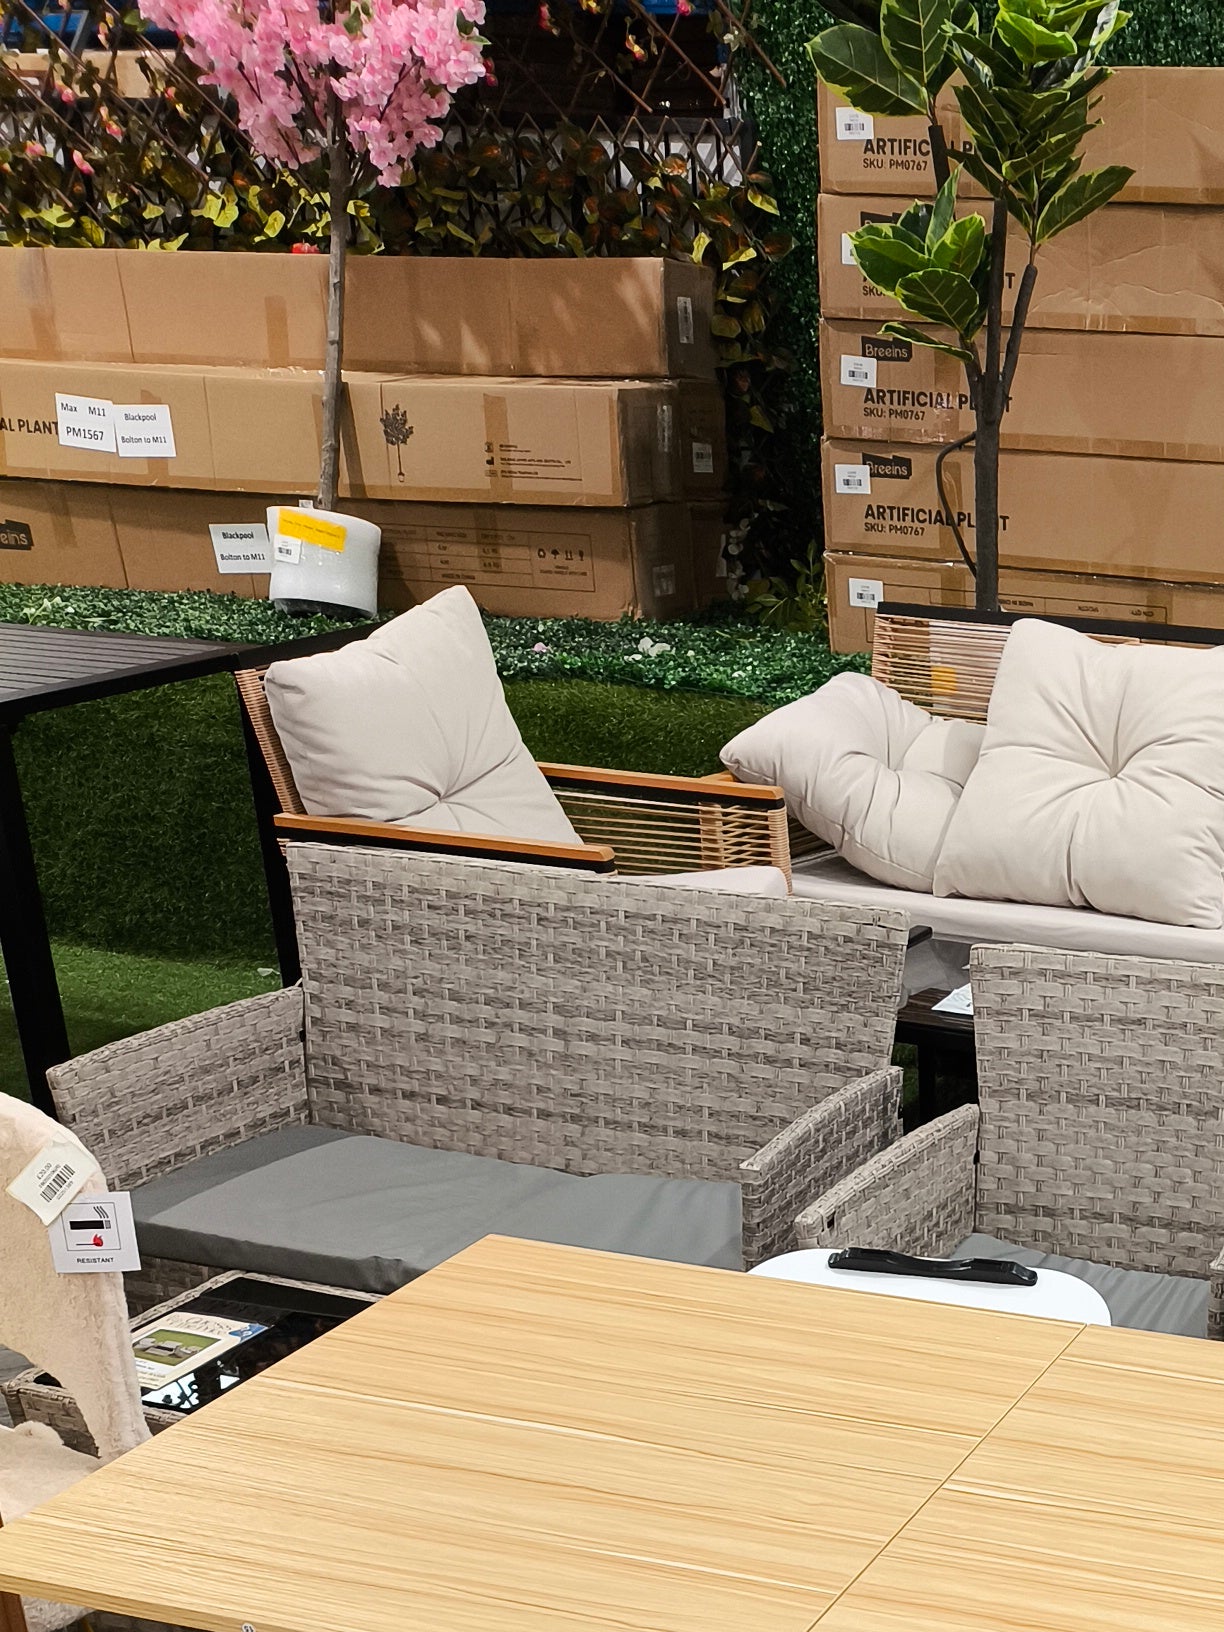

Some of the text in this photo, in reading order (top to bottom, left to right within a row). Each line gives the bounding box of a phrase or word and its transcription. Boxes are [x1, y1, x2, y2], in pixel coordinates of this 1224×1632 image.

[863, 138, 955, 156] ARTIFIC
[889, 159, 928, 171] PM0767
[865, 343, 908, 358] Breeins
[863, 388, 1013, 412] ARTIFICIAL PLT
[60, 402, 106, 417] Max M11
[889, 408, 925, 421] PM0767
[124, 413, 157, 422] Blackpool
[66, 426, 104, 441] PM1567
[864, 504, 1010, 531] ARTIFICIAL PLT
[221, 531, 254, 540] Blackpool
[889, 526, 925, 536] PM0767
